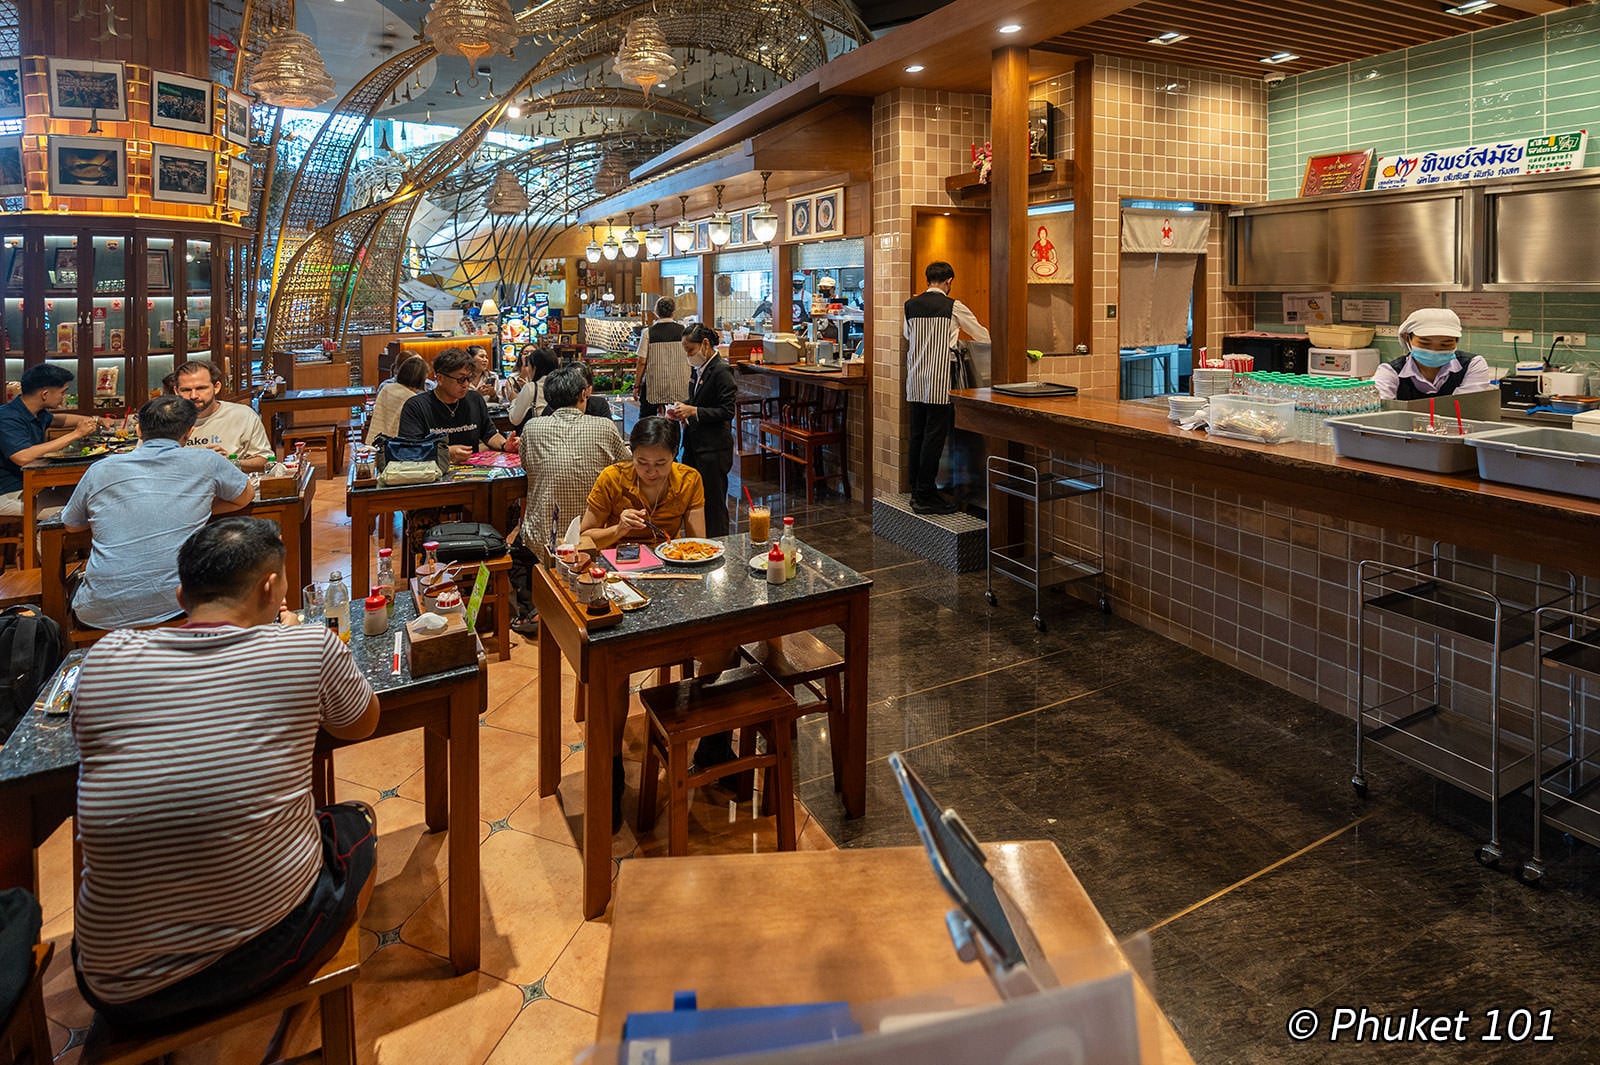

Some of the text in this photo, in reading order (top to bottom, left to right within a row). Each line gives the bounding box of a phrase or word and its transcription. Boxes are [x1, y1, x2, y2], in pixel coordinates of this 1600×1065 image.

[1420, 144, 1524, 173] ทิพย์สมัย
[186, 436, 210, 447] ake
